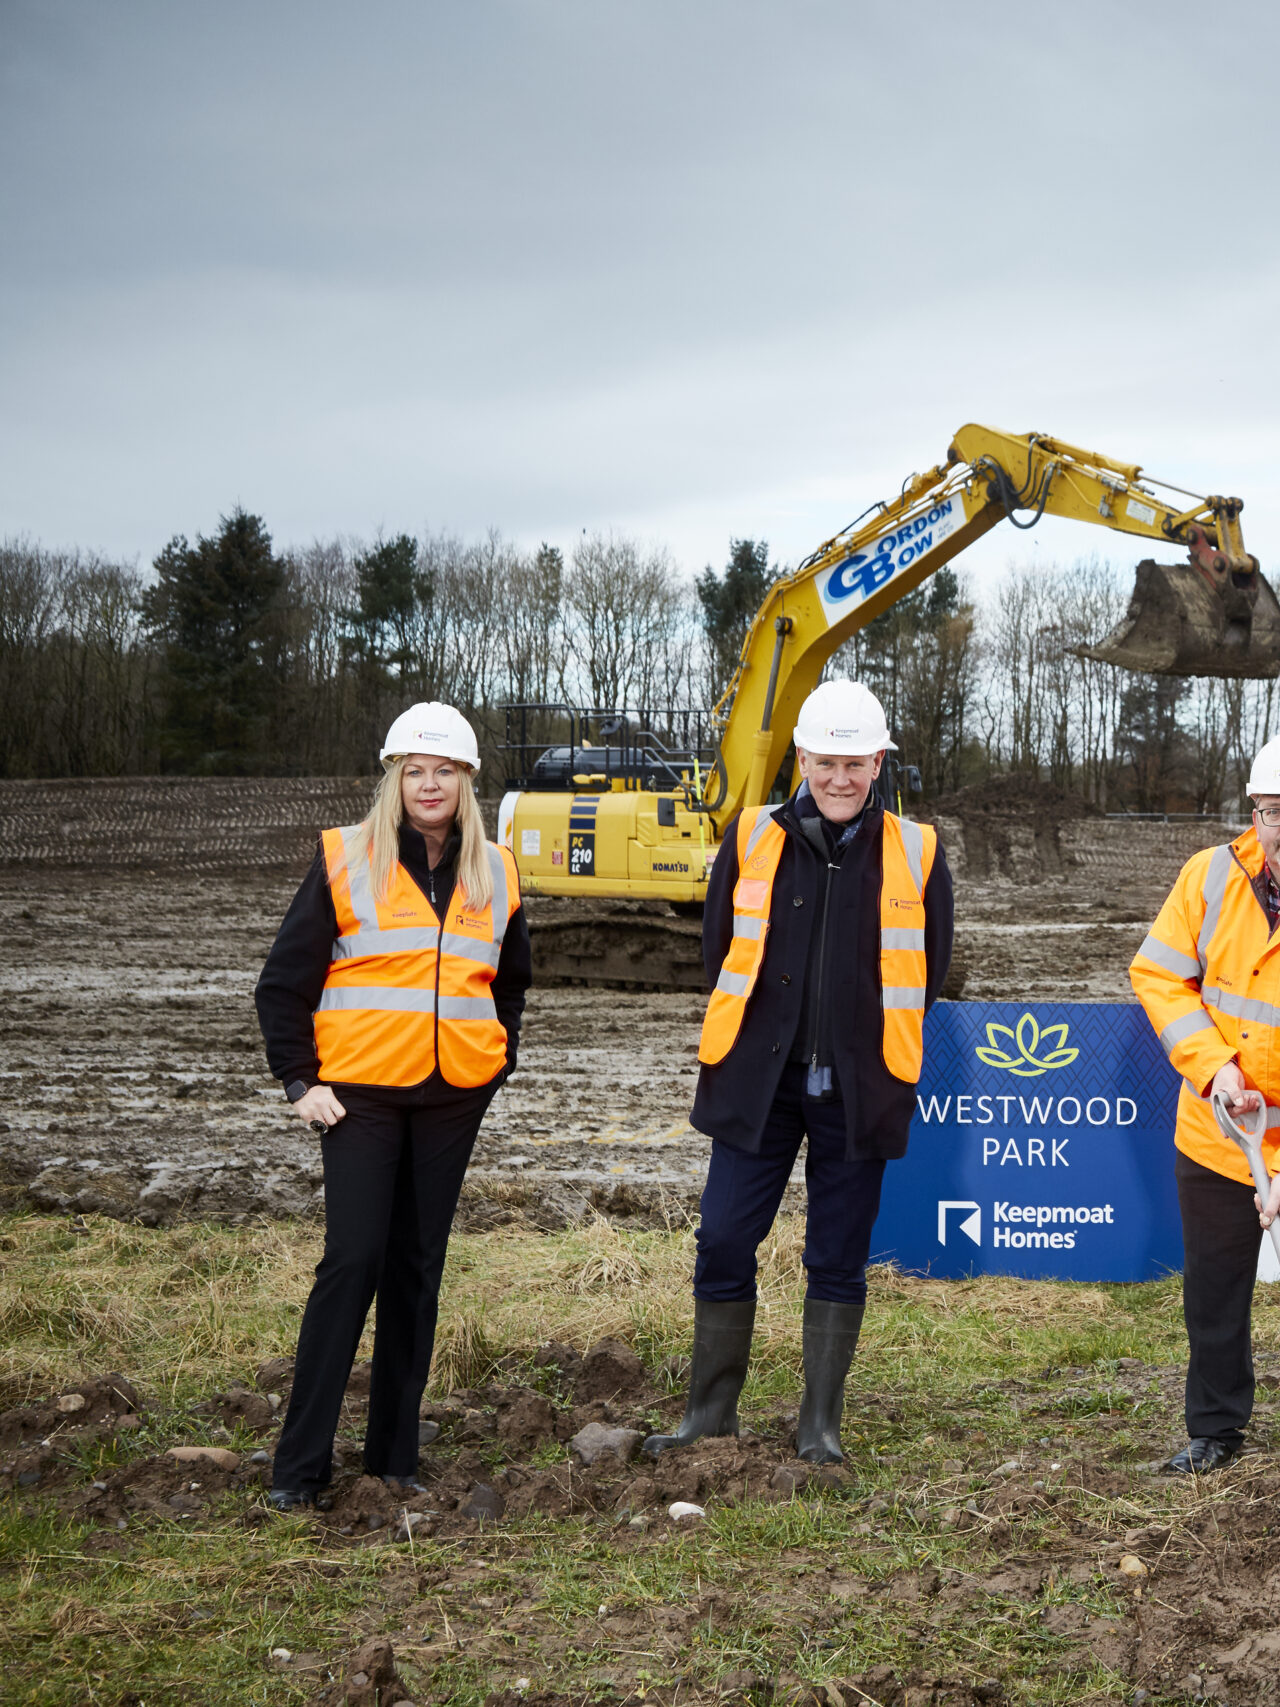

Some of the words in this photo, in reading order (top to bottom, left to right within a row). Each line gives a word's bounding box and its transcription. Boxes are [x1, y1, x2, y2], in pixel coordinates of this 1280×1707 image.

[572, 837, 584, 847] PC
[571, 849, 592, 864] 210
[571, 864, 581, 873] LC
[652, 861, 689, 872] KOMATSU
[916, 1095, 1138, 1126] WESTWOOD
[983, 1138, 1070, 1167] PARK
[993, 1201, 1114, 1228] Keepmoat
[993, 1227, 1078, 1249] Homes
